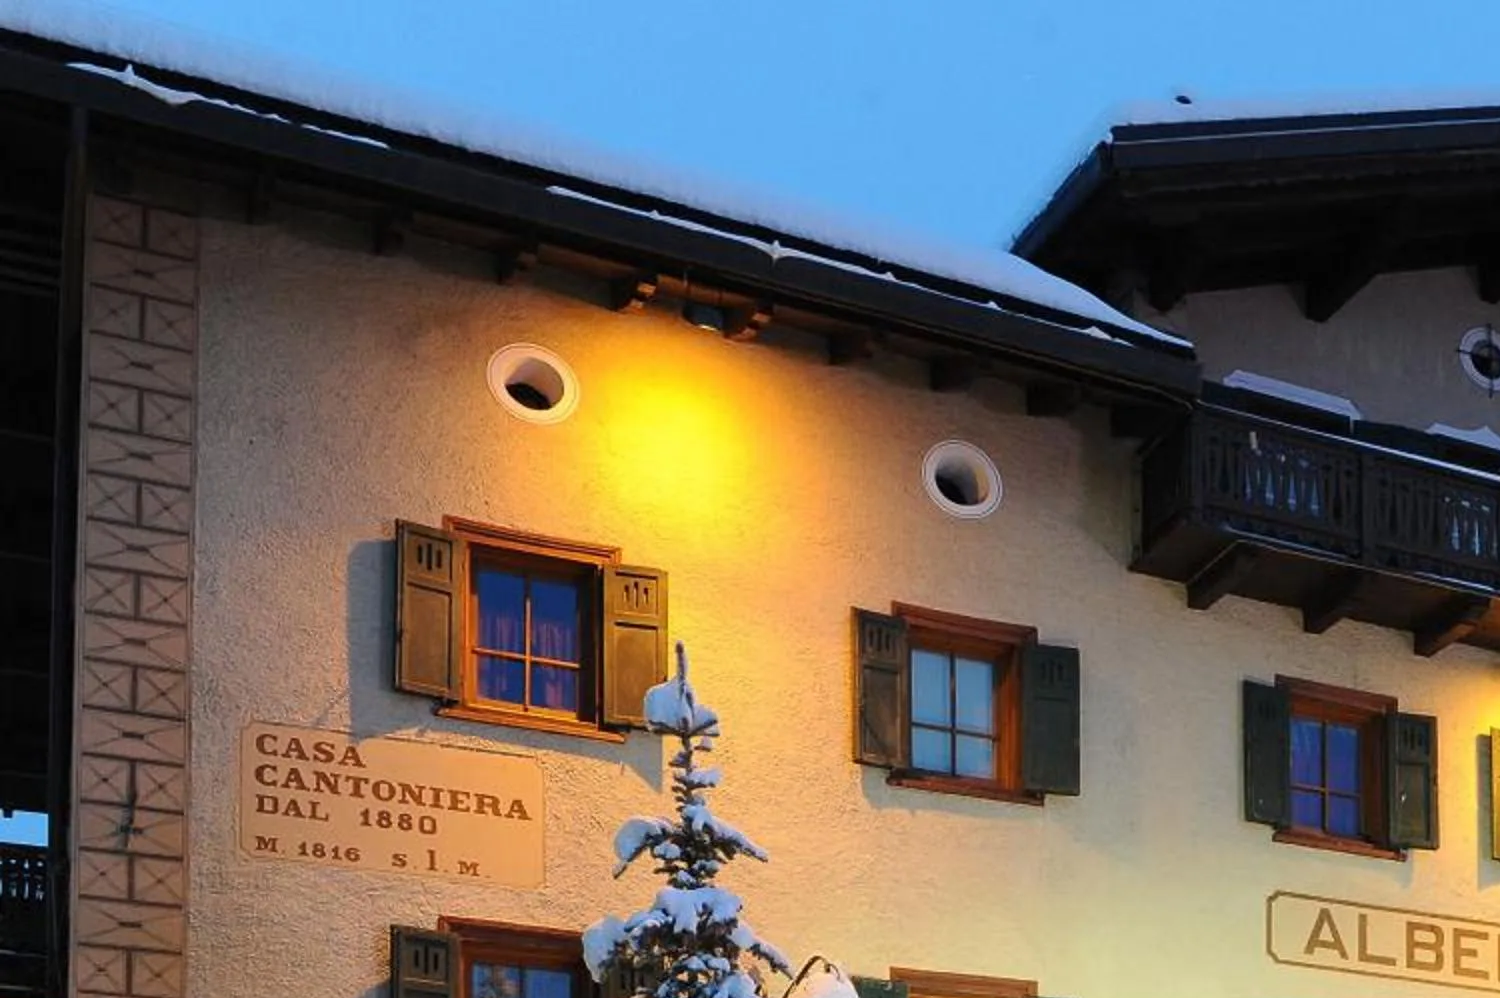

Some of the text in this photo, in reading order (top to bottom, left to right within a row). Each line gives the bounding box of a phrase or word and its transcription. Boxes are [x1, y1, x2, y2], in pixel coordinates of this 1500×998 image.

[255, 733, 366, 769] CASA
[254, 763, 532, 821] CANTONIERA
[255, 794, 438, 836] DAL 1880
[297, 842, 361, 863] 1816
